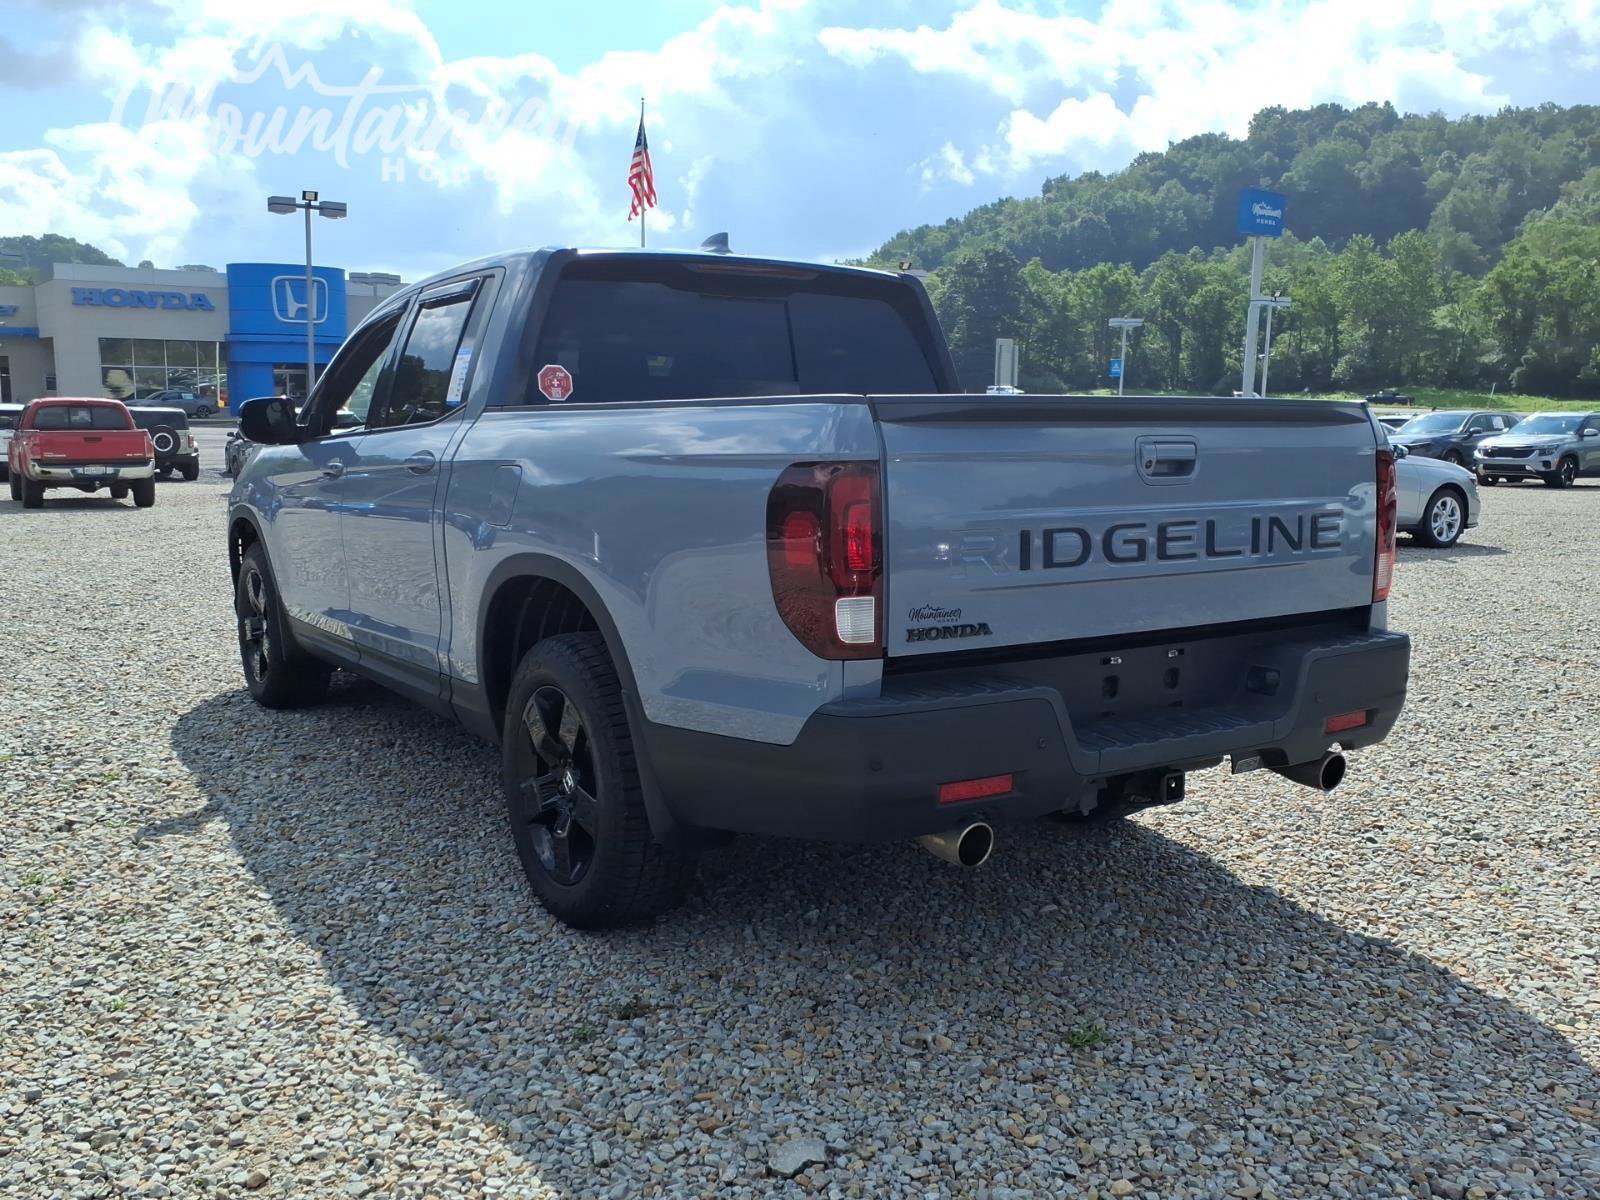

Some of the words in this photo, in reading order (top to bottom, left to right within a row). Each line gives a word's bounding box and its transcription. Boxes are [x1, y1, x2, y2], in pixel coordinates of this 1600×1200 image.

[71, 287, 215, 311] HONDA
[950, 508, 1344, 579] RIDGELINE
[908, 604, 962, 622] Mountaineer
[906, 622, 993, 643] HONDA
